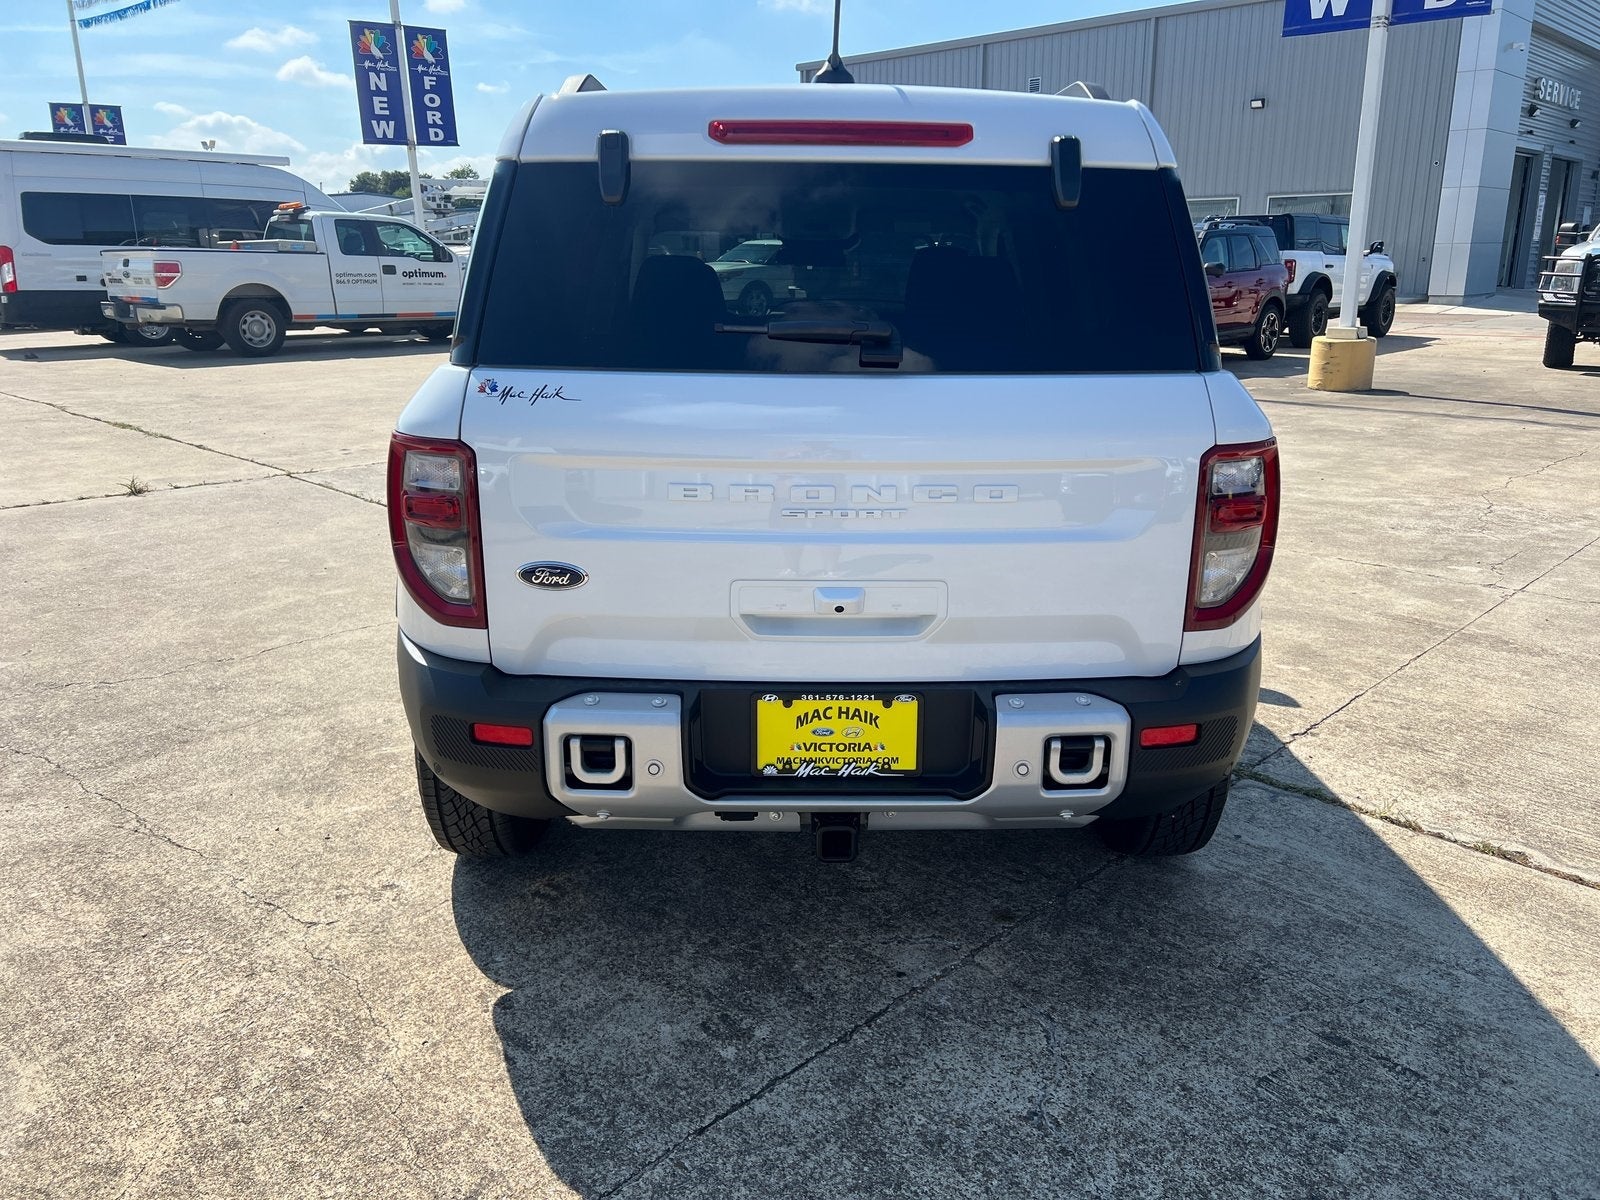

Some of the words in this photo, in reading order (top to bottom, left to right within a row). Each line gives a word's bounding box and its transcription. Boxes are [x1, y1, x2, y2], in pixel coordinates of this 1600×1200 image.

[1539, 77, 1581, 109] SERVICE
[368, 72, 395, 138] NEW
[423, 76, 445, 141] FORD
[495, 386, 526, 405] Mac
[529, 384, 576, 406] Haik
[667, 482, 1020, 503] BRONCO
[781, 509, 908, 519] SPORT
[531, 567, 571, 585] Ford
[795, 706, 833, 729] MAC
[838, 706, 880, 729] HAIK
[802, 742, 873, 752] VICTORIA
[792, 762, 834, 777] Mac
[837, 762, 891, 777] Haik
